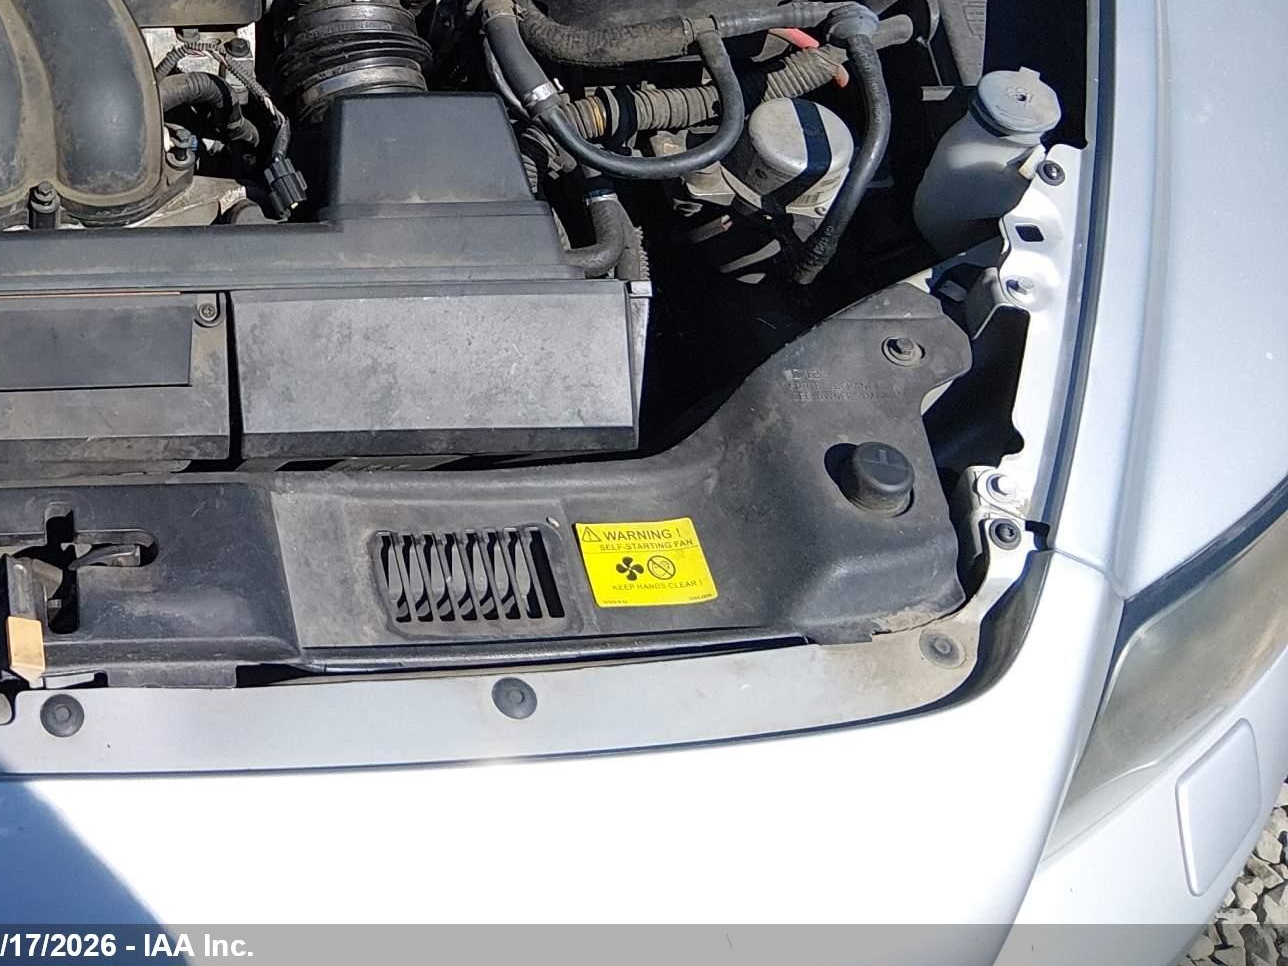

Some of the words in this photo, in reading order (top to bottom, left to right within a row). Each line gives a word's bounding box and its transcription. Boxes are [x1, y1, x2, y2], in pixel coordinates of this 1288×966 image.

[603, 529, 672, 541] WARNING
[600, 542, 673, 552] SELF-STARTING
[674, 539, 693, 548] FAN
[612, 582, 635, 591] KEEP
[637, 582, 666, 590] HANDS
[668, 580, 697, 589] CLEAR
